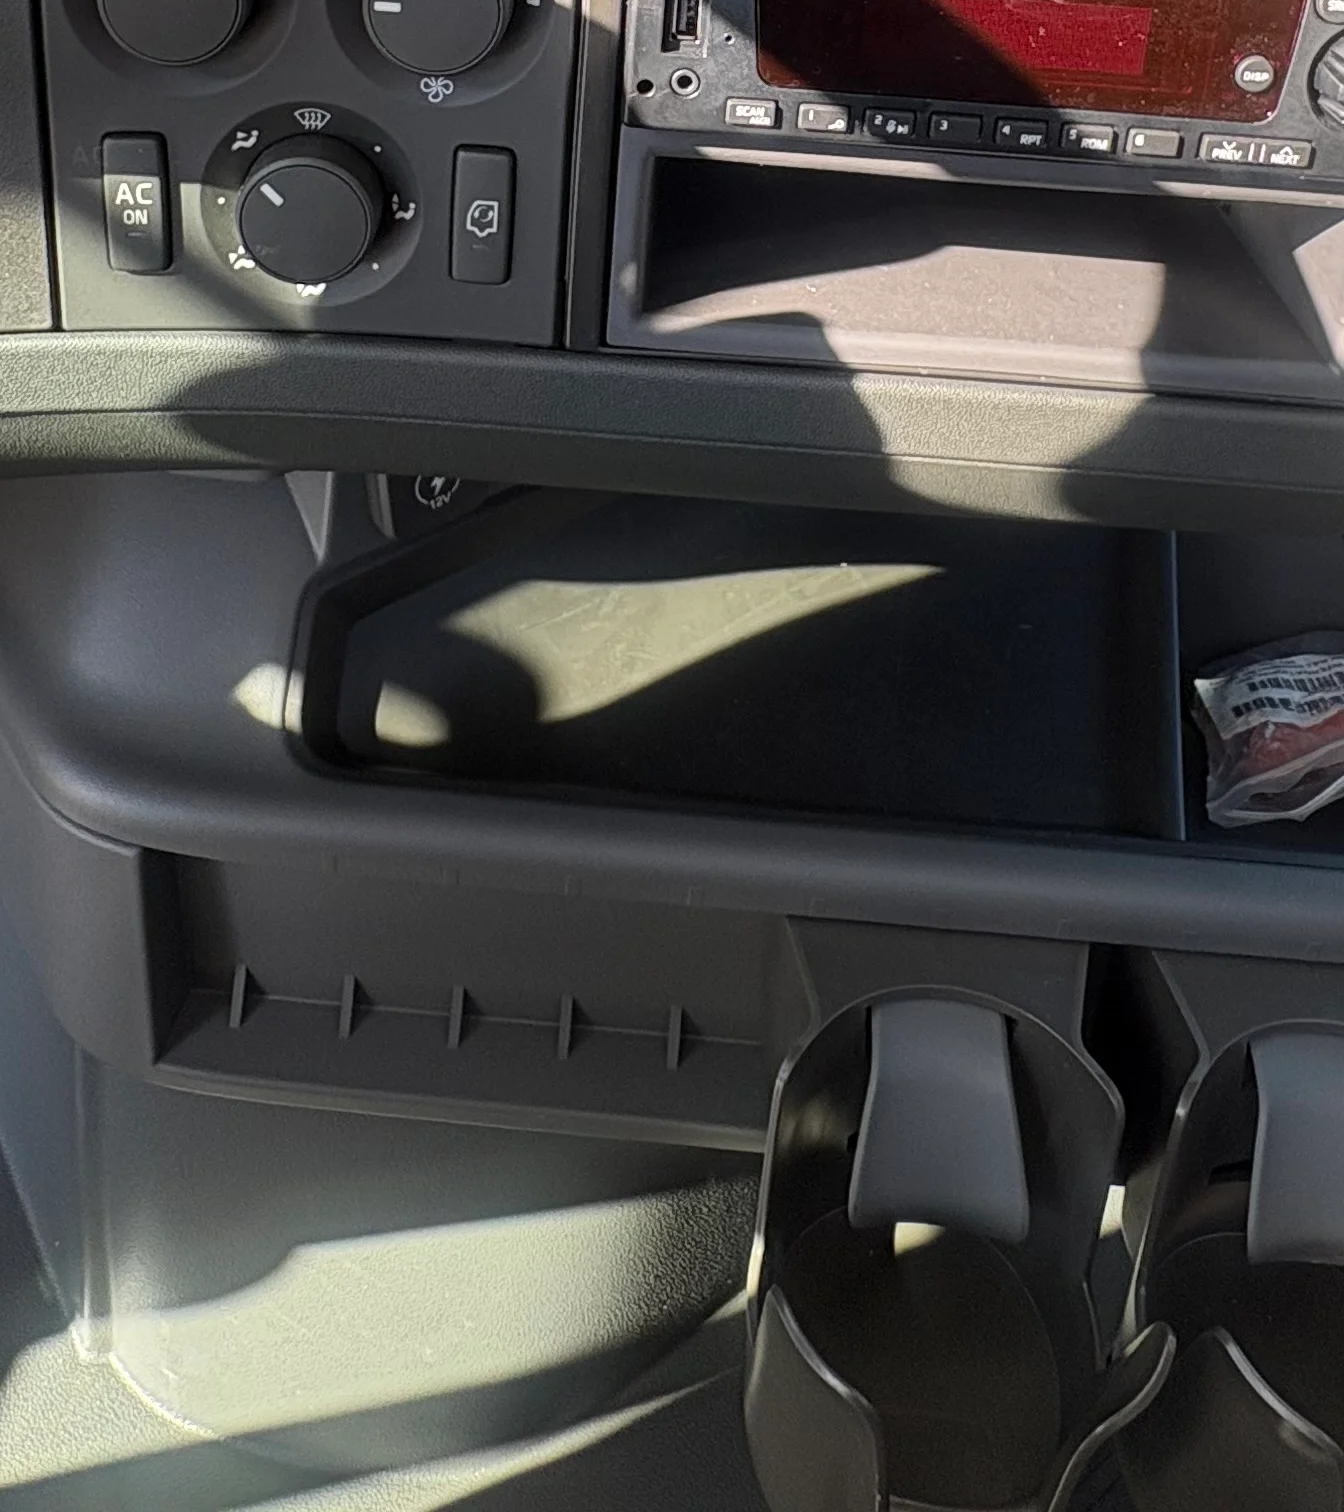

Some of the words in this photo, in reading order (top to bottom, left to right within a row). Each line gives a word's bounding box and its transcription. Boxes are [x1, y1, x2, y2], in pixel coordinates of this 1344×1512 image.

[1242, 69, 1270, 83] DISP
[735, 105, 765, 117] SCAN
[874, 115, 883, 125] 2
[939, 120, 948, 131] 3
[1002, 125, 1011, 135] 4
[1019, 134, 1042, 146] RPT
[1068, 129, 1078, 140] 5
[1211, 147, 1243, 161] PREV
[1270, 153, 1301, 165] NEXT
[115, 182, 153, 205] AC
[123, 209, 148, 225] ON
[430, 491, 452, 509] 12V
